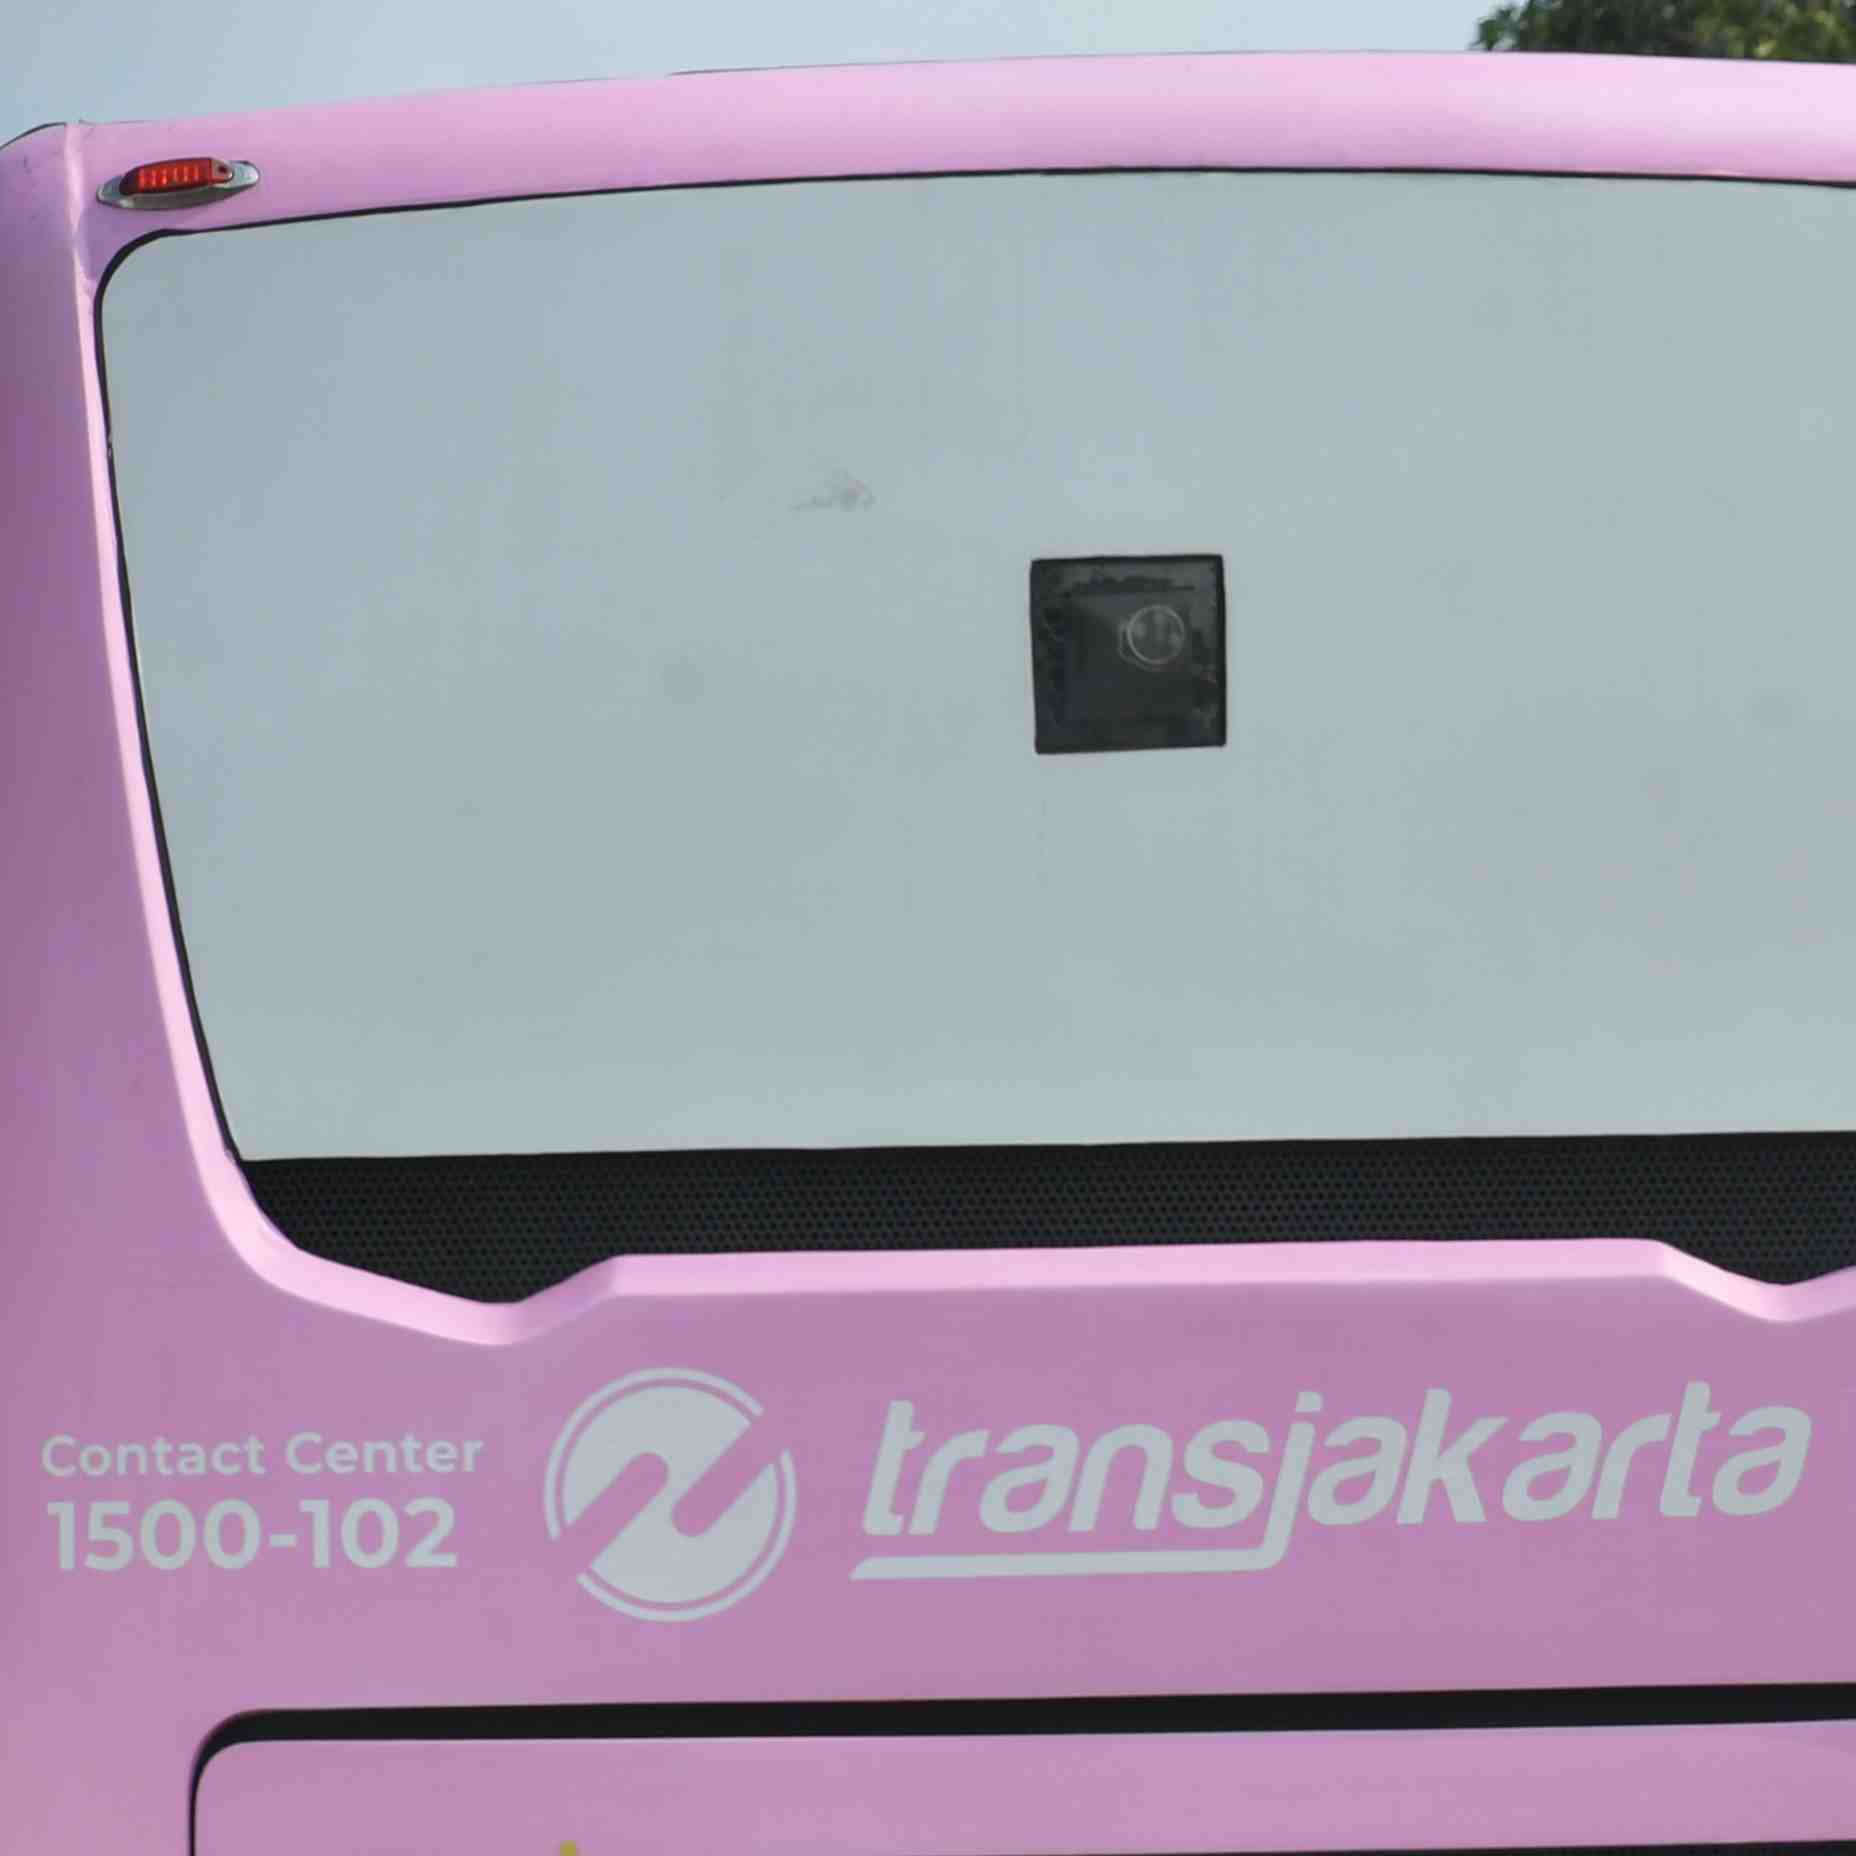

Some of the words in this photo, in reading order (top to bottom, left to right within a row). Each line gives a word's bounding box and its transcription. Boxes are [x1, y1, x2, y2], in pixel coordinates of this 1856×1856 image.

[40, 1435, 266, 1478] Contact
[284, 1432, 485, 1475] Center
[861, 1379, 1813, 1576] transjakarta
[46, 1496, 459, 1573] 1500-102
